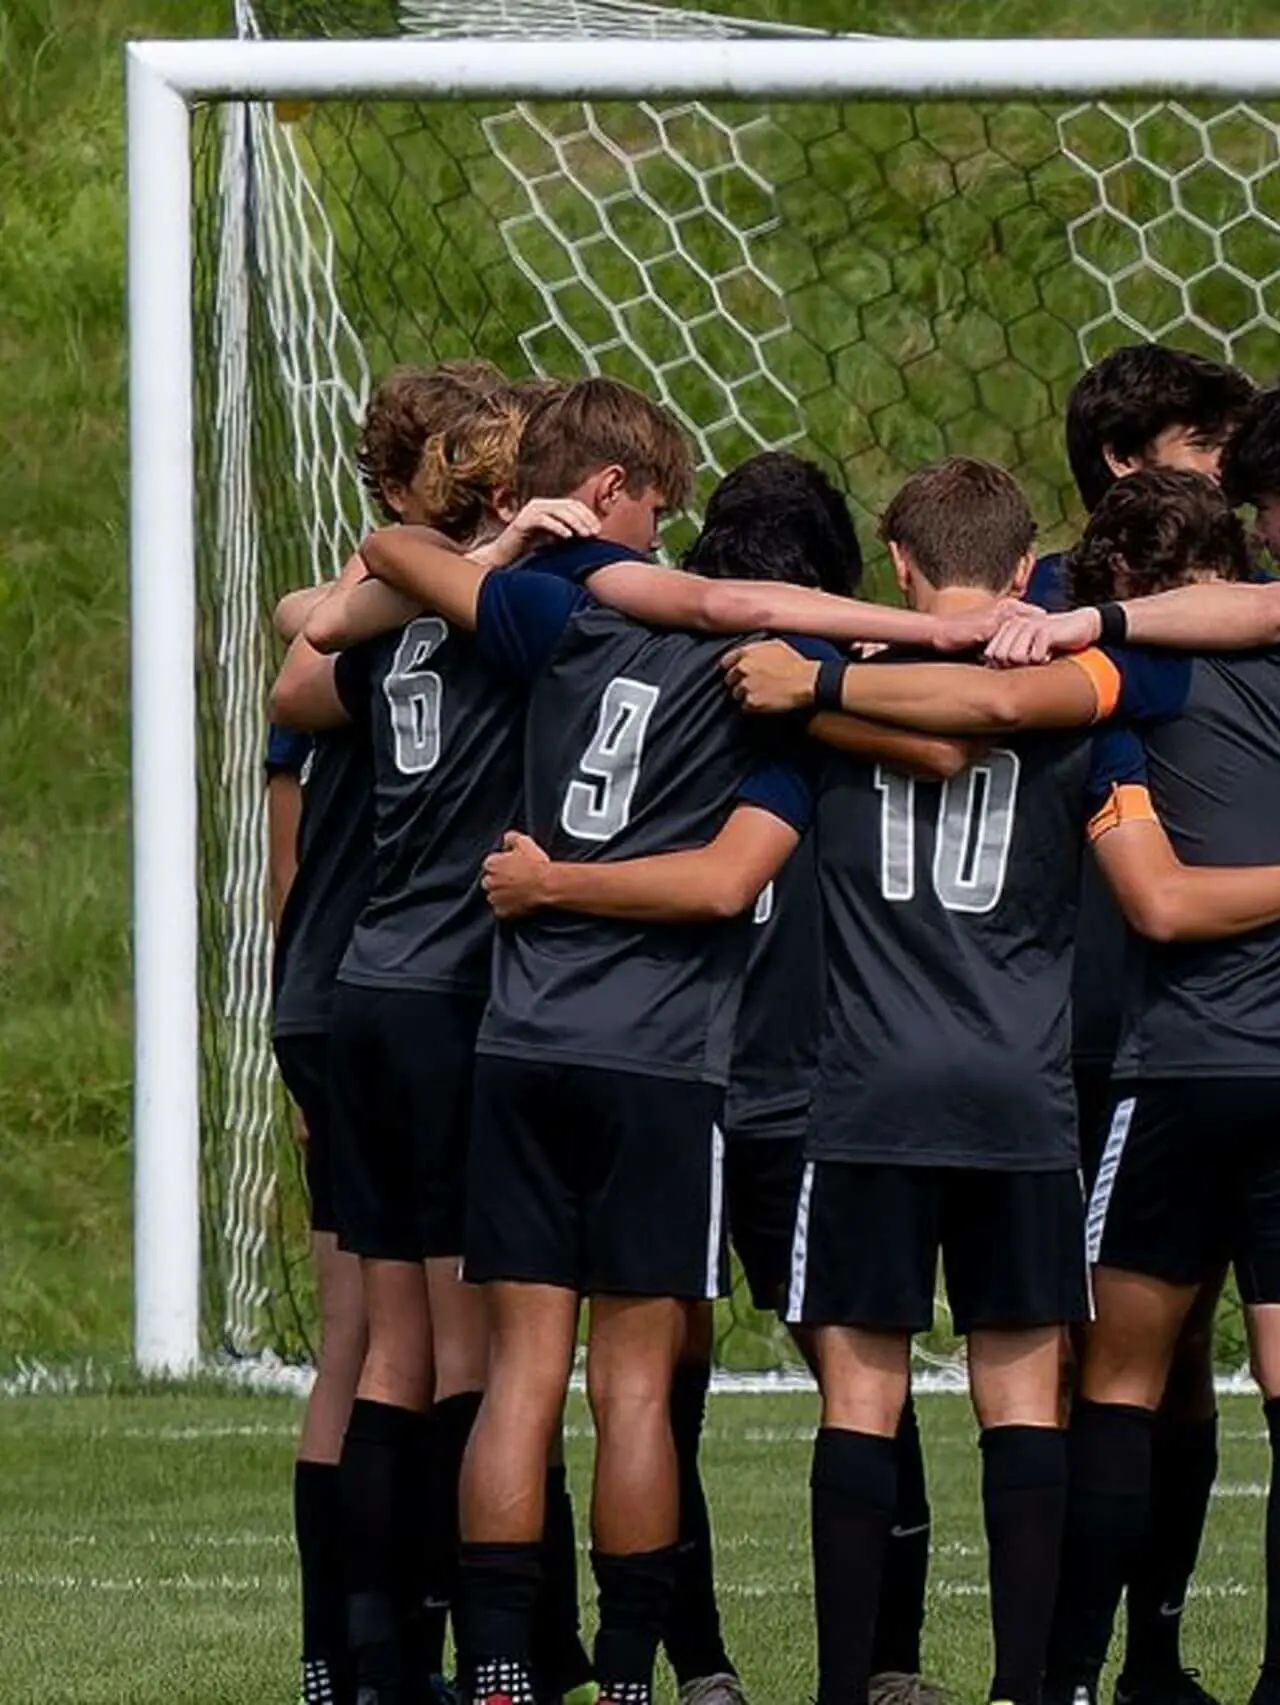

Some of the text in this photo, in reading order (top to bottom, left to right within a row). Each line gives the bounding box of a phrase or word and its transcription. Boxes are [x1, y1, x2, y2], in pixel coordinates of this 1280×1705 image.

[383, 617, 449, 775] 6
[561, 677, 660, 841] 9
[874, 750, 1020, 913] 10
